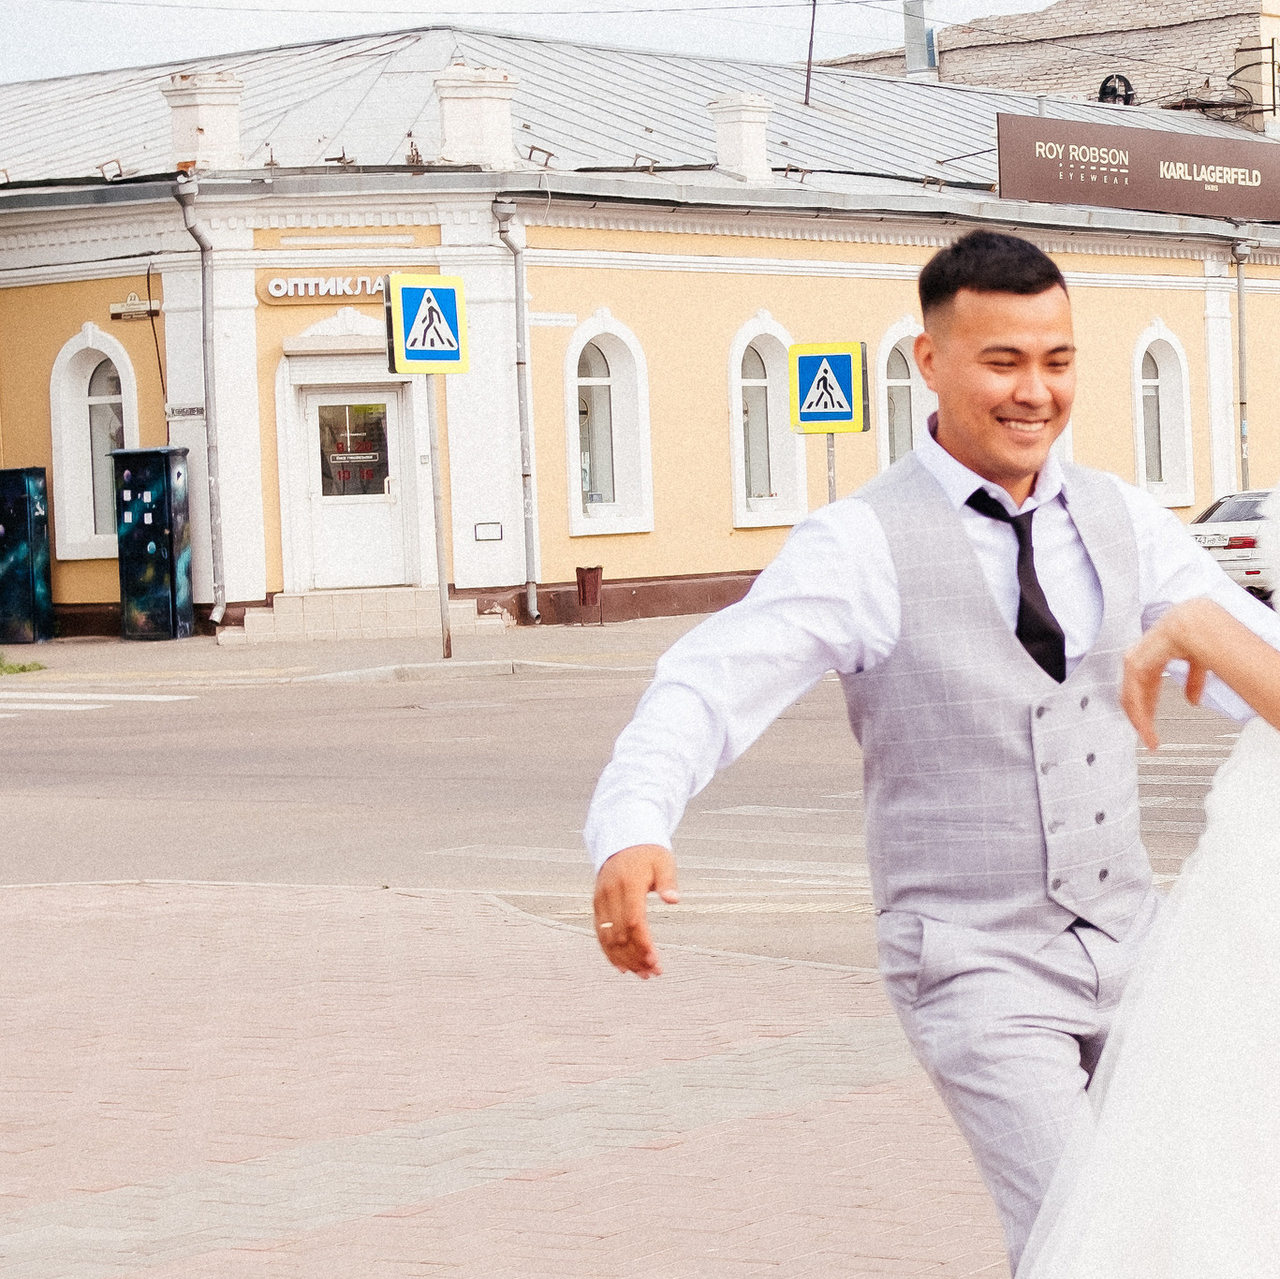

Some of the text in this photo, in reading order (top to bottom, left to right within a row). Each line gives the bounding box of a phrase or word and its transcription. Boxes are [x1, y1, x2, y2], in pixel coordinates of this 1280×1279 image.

[1035, 141, 1129, 166] ROY ROBSON
[1059, 171, 1129, 186] EYEWEAR
[1159, 160, 1262, 187] KARL LAGERFELD
[268, 275, 384, 298] ОПТИКЛА
